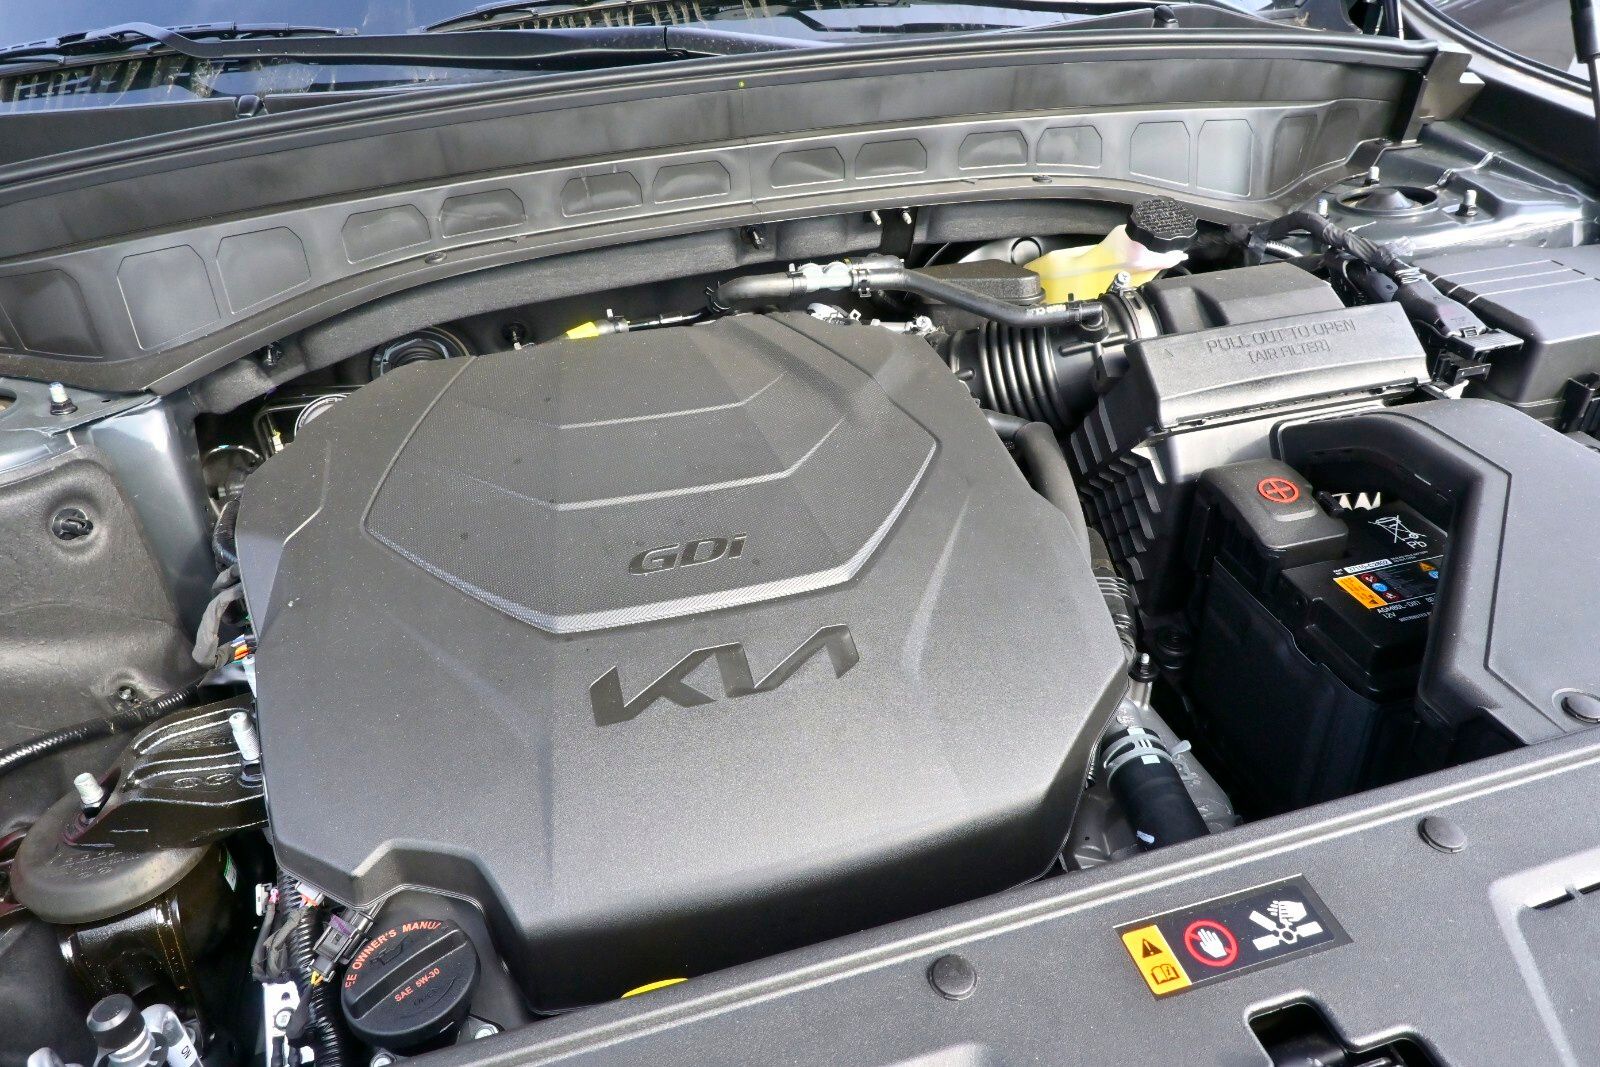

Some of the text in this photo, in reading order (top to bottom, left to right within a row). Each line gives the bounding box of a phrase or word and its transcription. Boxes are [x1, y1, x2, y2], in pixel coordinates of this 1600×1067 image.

[1206, 318, 1357, 352] PULL OUT TO OPEN
[352, 929, 398, 970] OWNER'S
[402, 921, 442, 933] MANU
[394, 967, 441, 1002] SAE 5W-30
